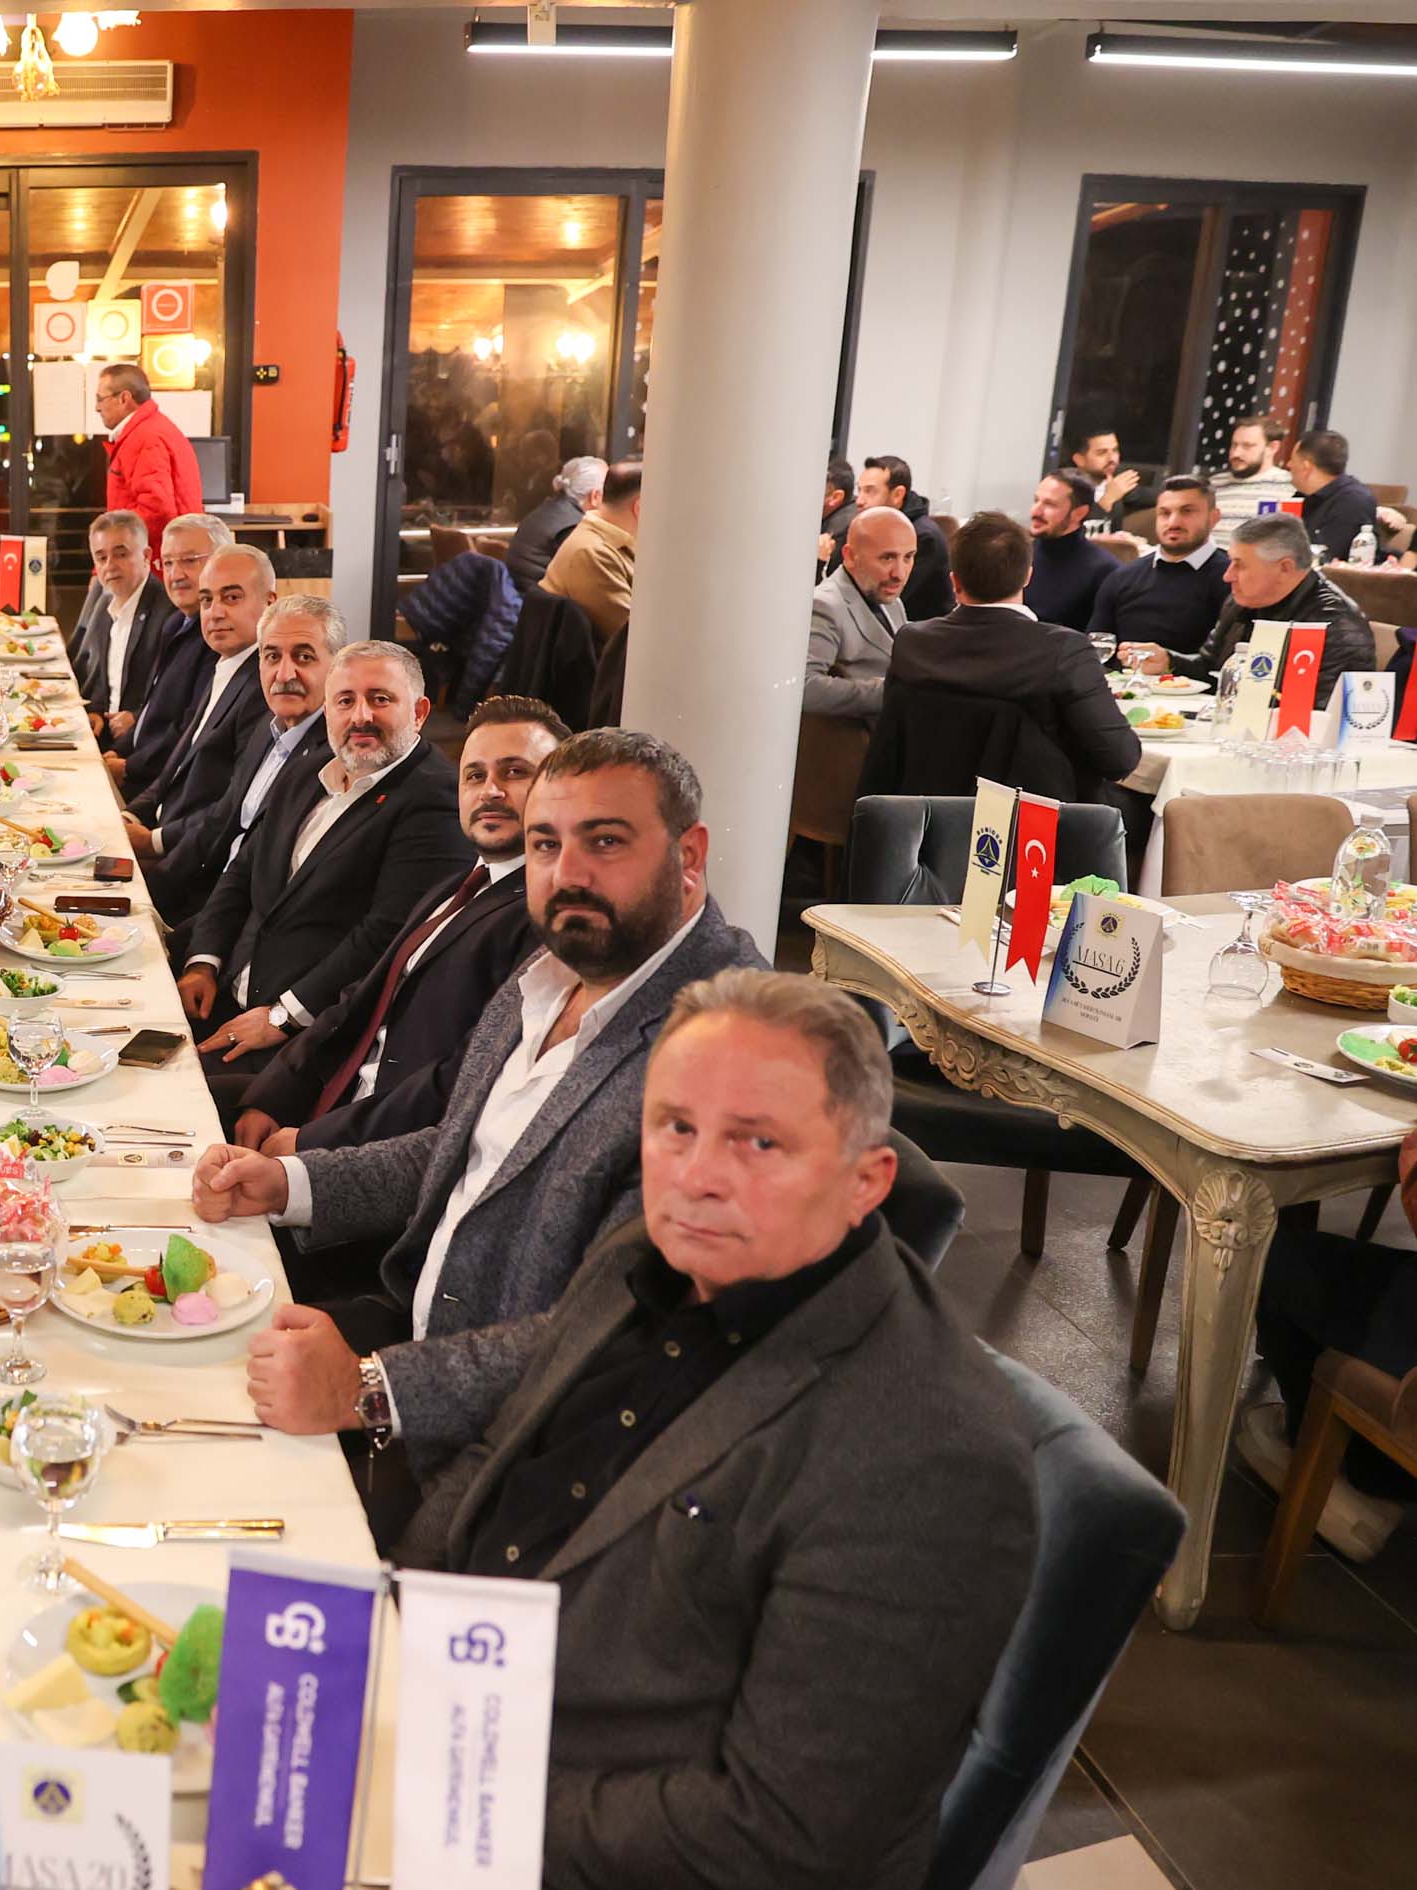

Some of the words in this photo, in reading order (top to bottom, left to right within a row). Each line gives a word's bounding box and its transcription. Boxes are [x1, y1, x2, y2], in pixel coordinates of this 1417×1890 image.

[290, 1672, 320, 1769] COLDWELL
[479, 1693, 500, 1786] COLDWELL
[284, 1771, 309, 1850] BANKER
[476, 1793, 496, 1868] BANKER
